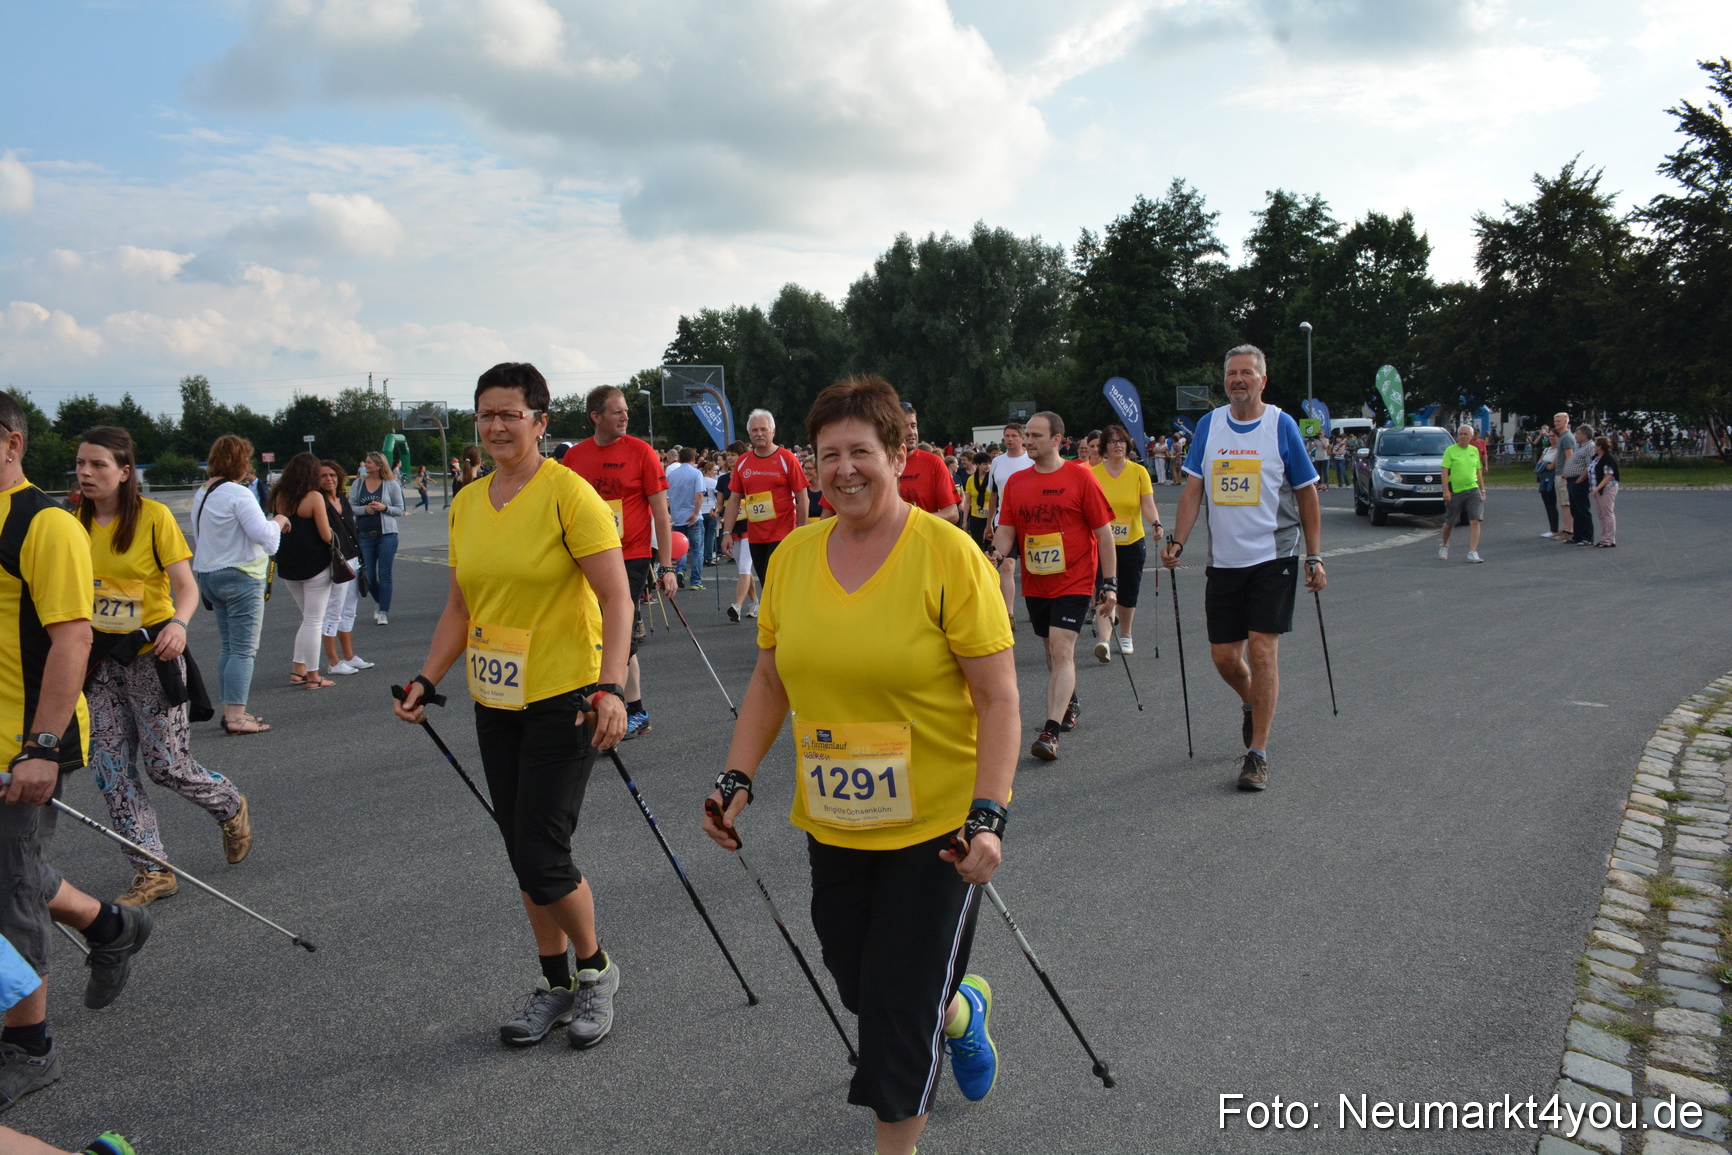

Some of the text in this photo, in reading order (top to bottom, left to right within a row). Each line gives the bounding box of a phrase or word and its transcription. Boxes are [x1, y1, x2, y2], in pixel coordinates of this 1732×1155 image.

[1221, 477, 1250, 492] 554
[753, 504, 765, 514] 92
[1027, 549, 1060, 564] 1472
[93, 598, 135, 617] 1271
[471, 653, 519, 687] 1292
[810, 765, 897, 800] 1291
[824, 804, 892, 815] Brigitte Ochsenkühn
